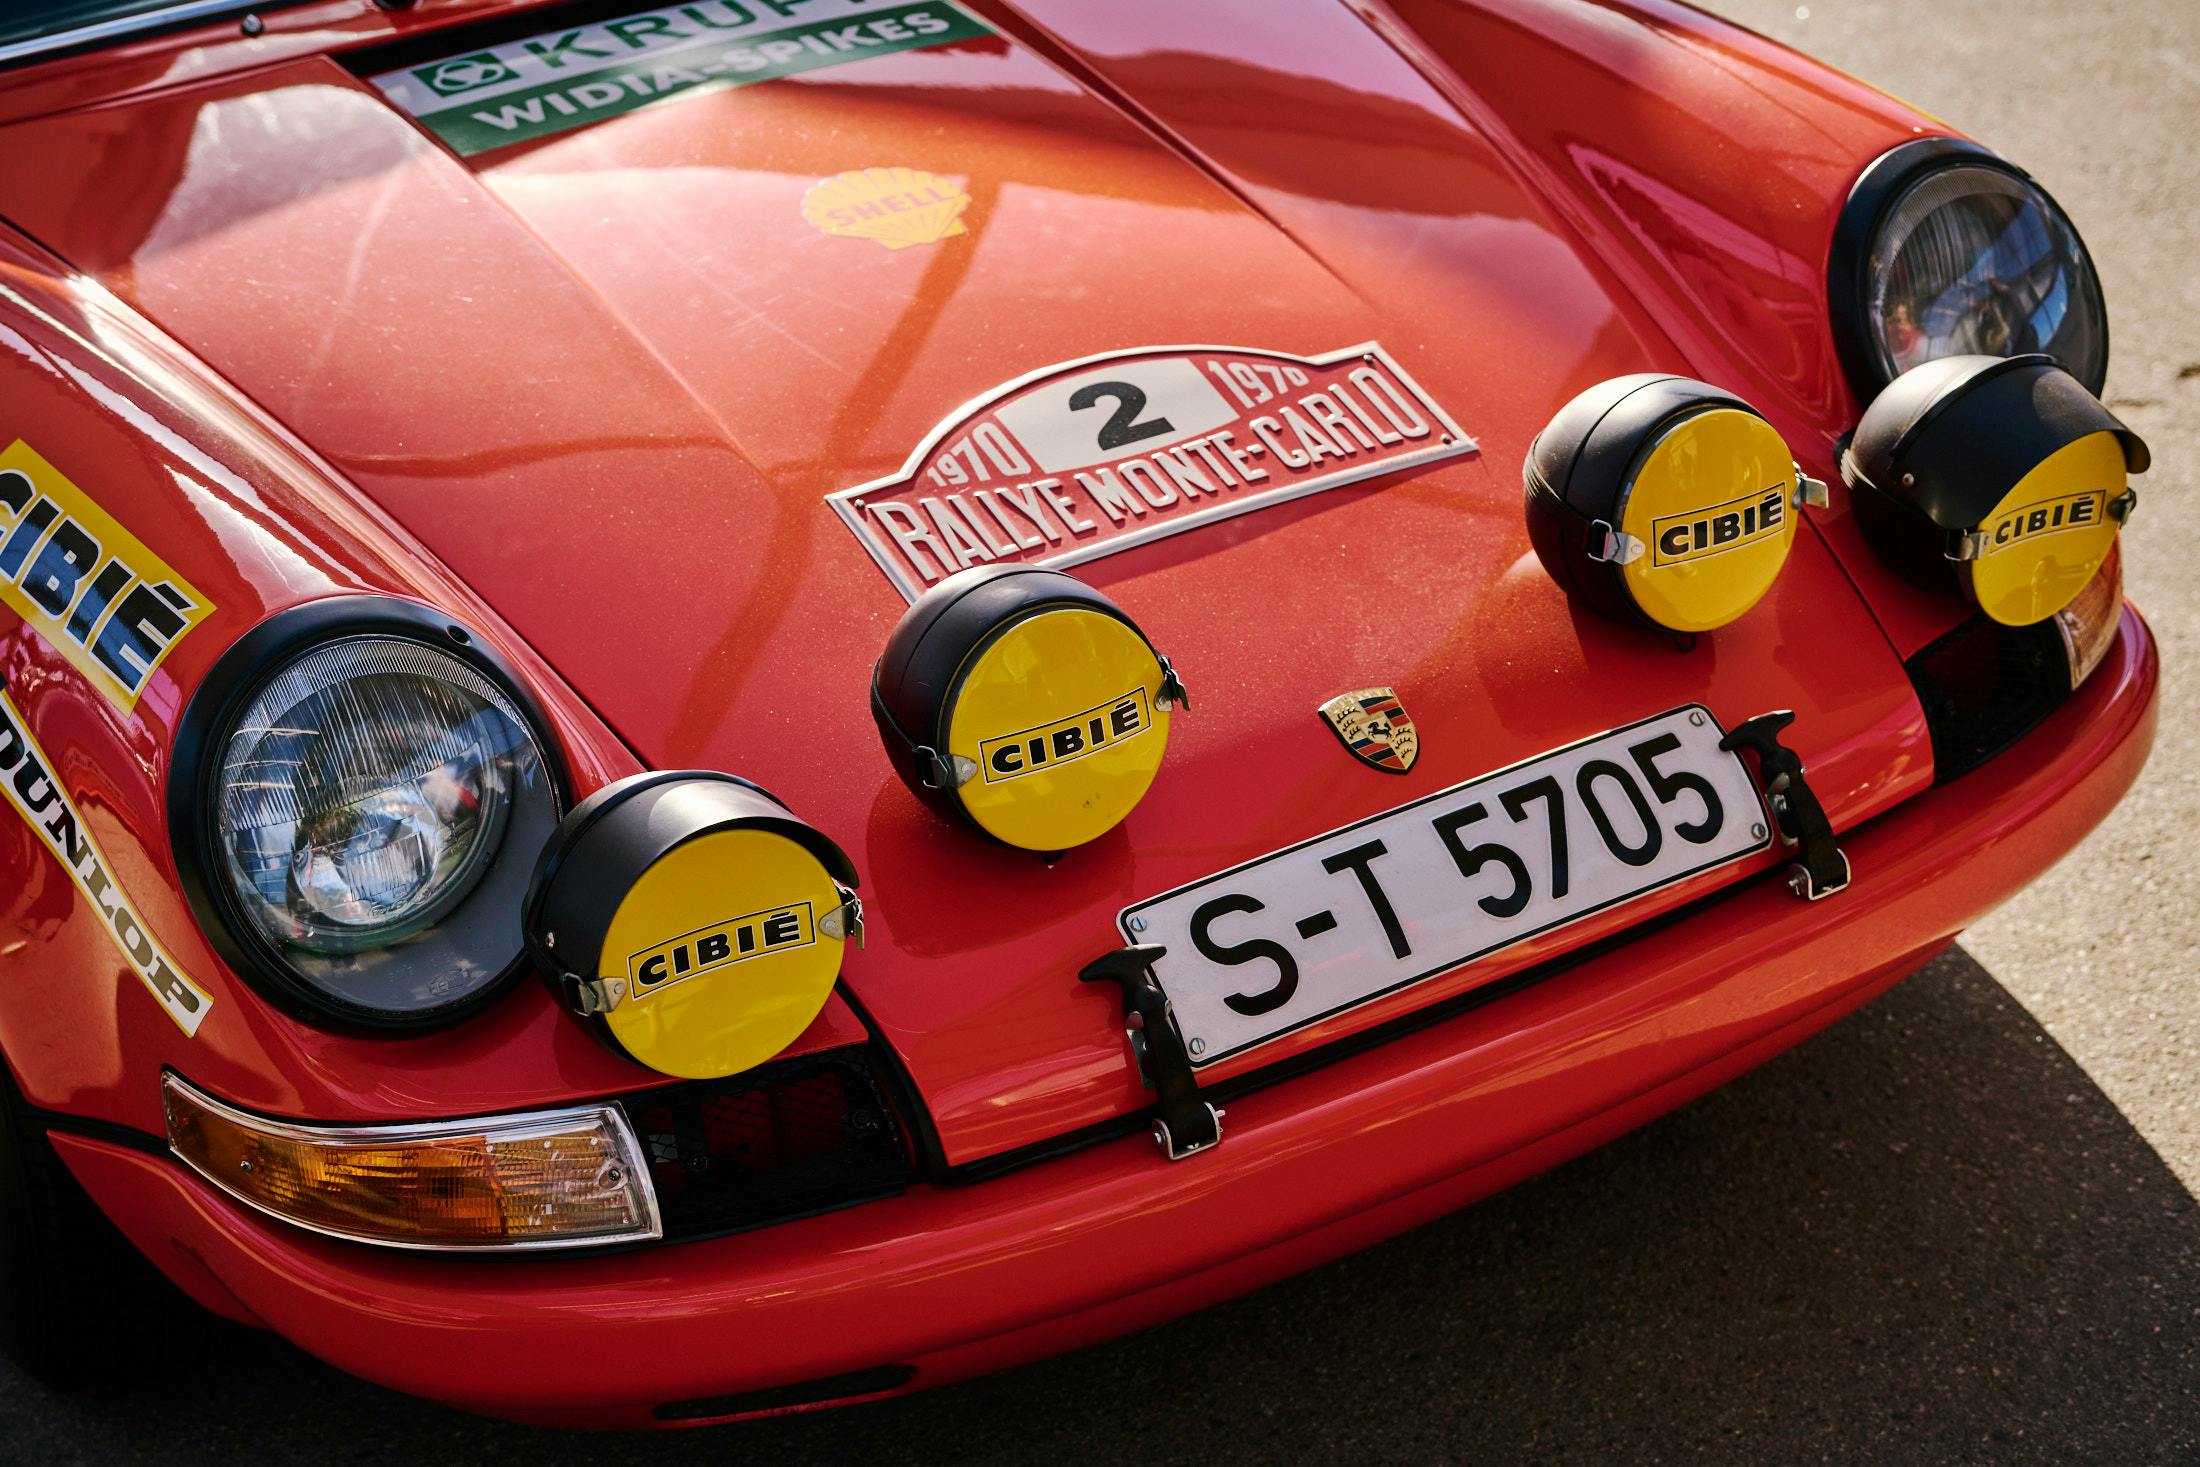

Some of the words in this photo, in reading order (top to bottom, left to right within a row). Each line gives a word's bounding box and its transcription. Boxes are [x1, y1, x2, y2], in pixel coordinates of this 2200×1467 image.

[473, 12, 949, 131] WIDIA-SPIKES
[523, 0, 866, 68] KRU
[826, 186, 956, 228] SHELL
[928, 422, 1032, 488] 1970
[1068, 381, 1176, 451] 2
[1206, 360, 1310, 409] 1970
[866, 480, 1097, 581] RALLYE
[1074, 366, 1430, 522] MONTE-CARLO
[1659, 490, 1783, 556] CIBIÉ
[1995, 495, 2095, 545] CIBIÉ
[991, 699, 1141, 774] CIBIÉ
[1189, 838, 1413, 1017] S-T
[1431, 732, 1724, 918] 5705
[637, 911, 801, 987] CIBIÉ
